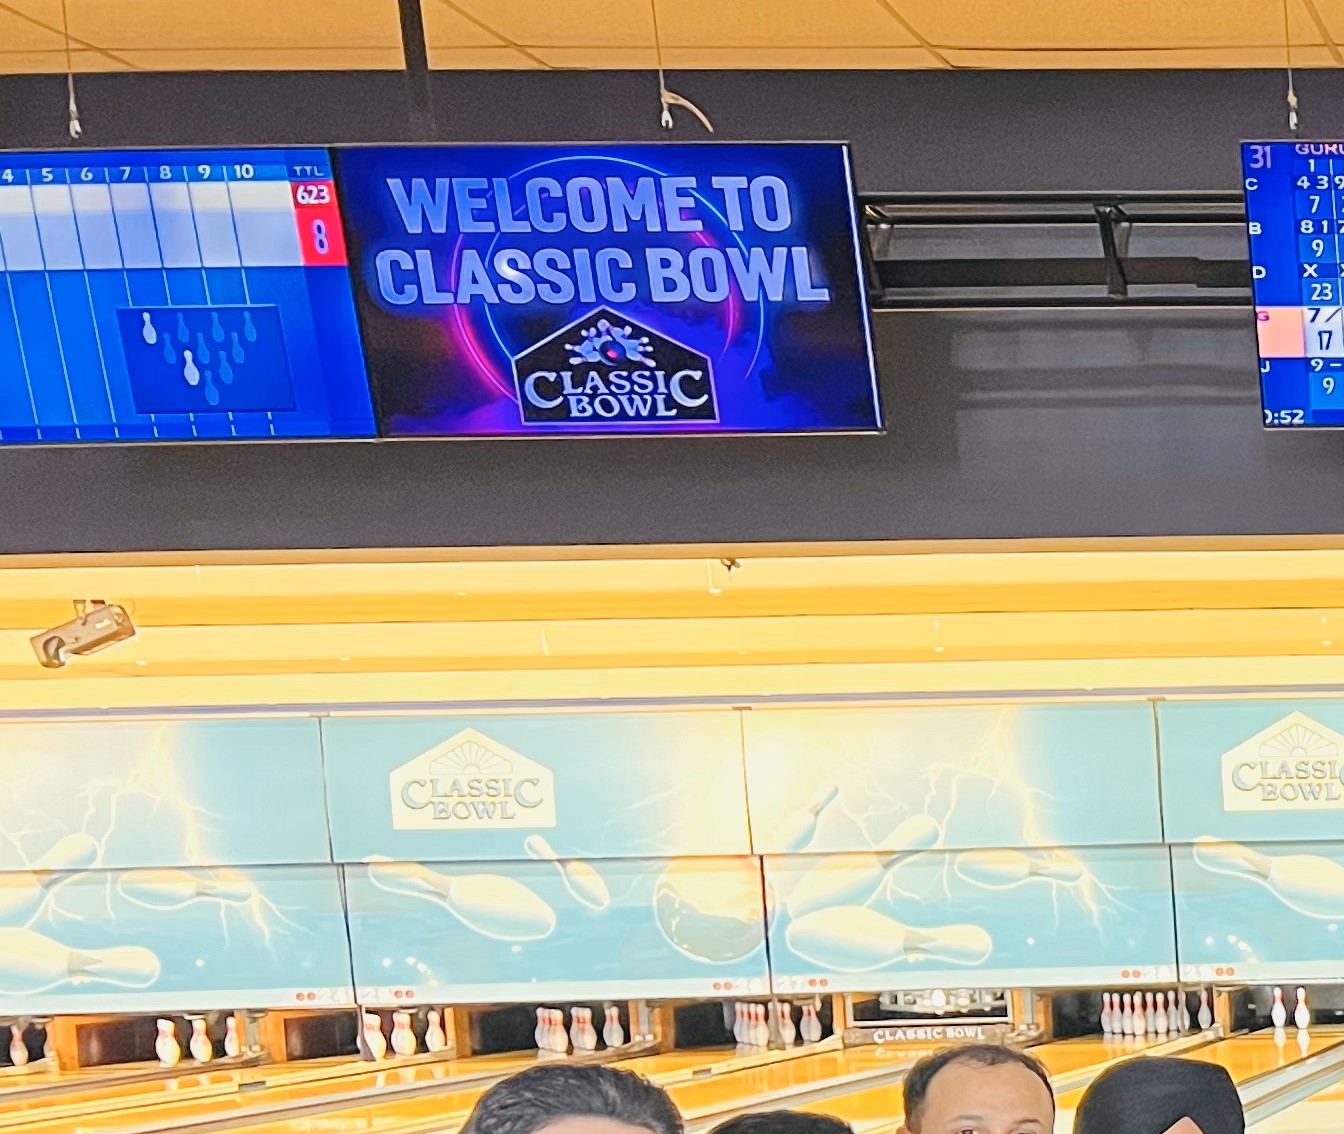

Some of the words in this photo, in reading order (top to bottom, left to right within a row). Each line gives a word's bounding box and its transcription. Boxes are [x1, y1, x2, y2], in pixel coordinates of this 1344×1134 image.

[1249, 144, 1272, 169] 31
[1308, 158, 1315, 173] 1
[1, 168, 14, 183] 4
[41, 167, 54, 182] 5
[80, 167, 94, 181] 6
[119, 166, 131, 181] 7
[159, 165, 172, 180] 8
[197, 164, 211, 179] 9
[232, 163, 256, 183] 10
[293, 165, 324, 177] TTL
[1245, 177, 1258, 191] C
[296, 184, 331, 205] 623
[384, 173, 706, 236] WELCOME
[717, 173, 792, 235] TO
[1309, 195, 1320, 214] 7
[313, 218, 329, 255] 8
[1248, 221, 1262, 235] B
[1311, 239, 1324, 258] 9
[376, 245, 640, 307] CLASSIC
[648, 245, 831, 304] BOWL
[1252, 265, 1267, 279] D
[1311, 282, 1333, 301] 23
[1317, 330, 1333, 351] 17
[1260, 360, 1271, 373] J
[525, 369, 709, 409] CLASSIC
[1322, 377, 1335, 395] 9
[568, 393, 678, 418] BOWL
[401, 778, 544, 809] CLASSIC
[1260, 783, 1341, 801] BOWL
[432, 801, 516, 820] BOWL
[873, 1027, 942, 1043] CLASSIC
[946, 1026, 985, 1040] BOWL
